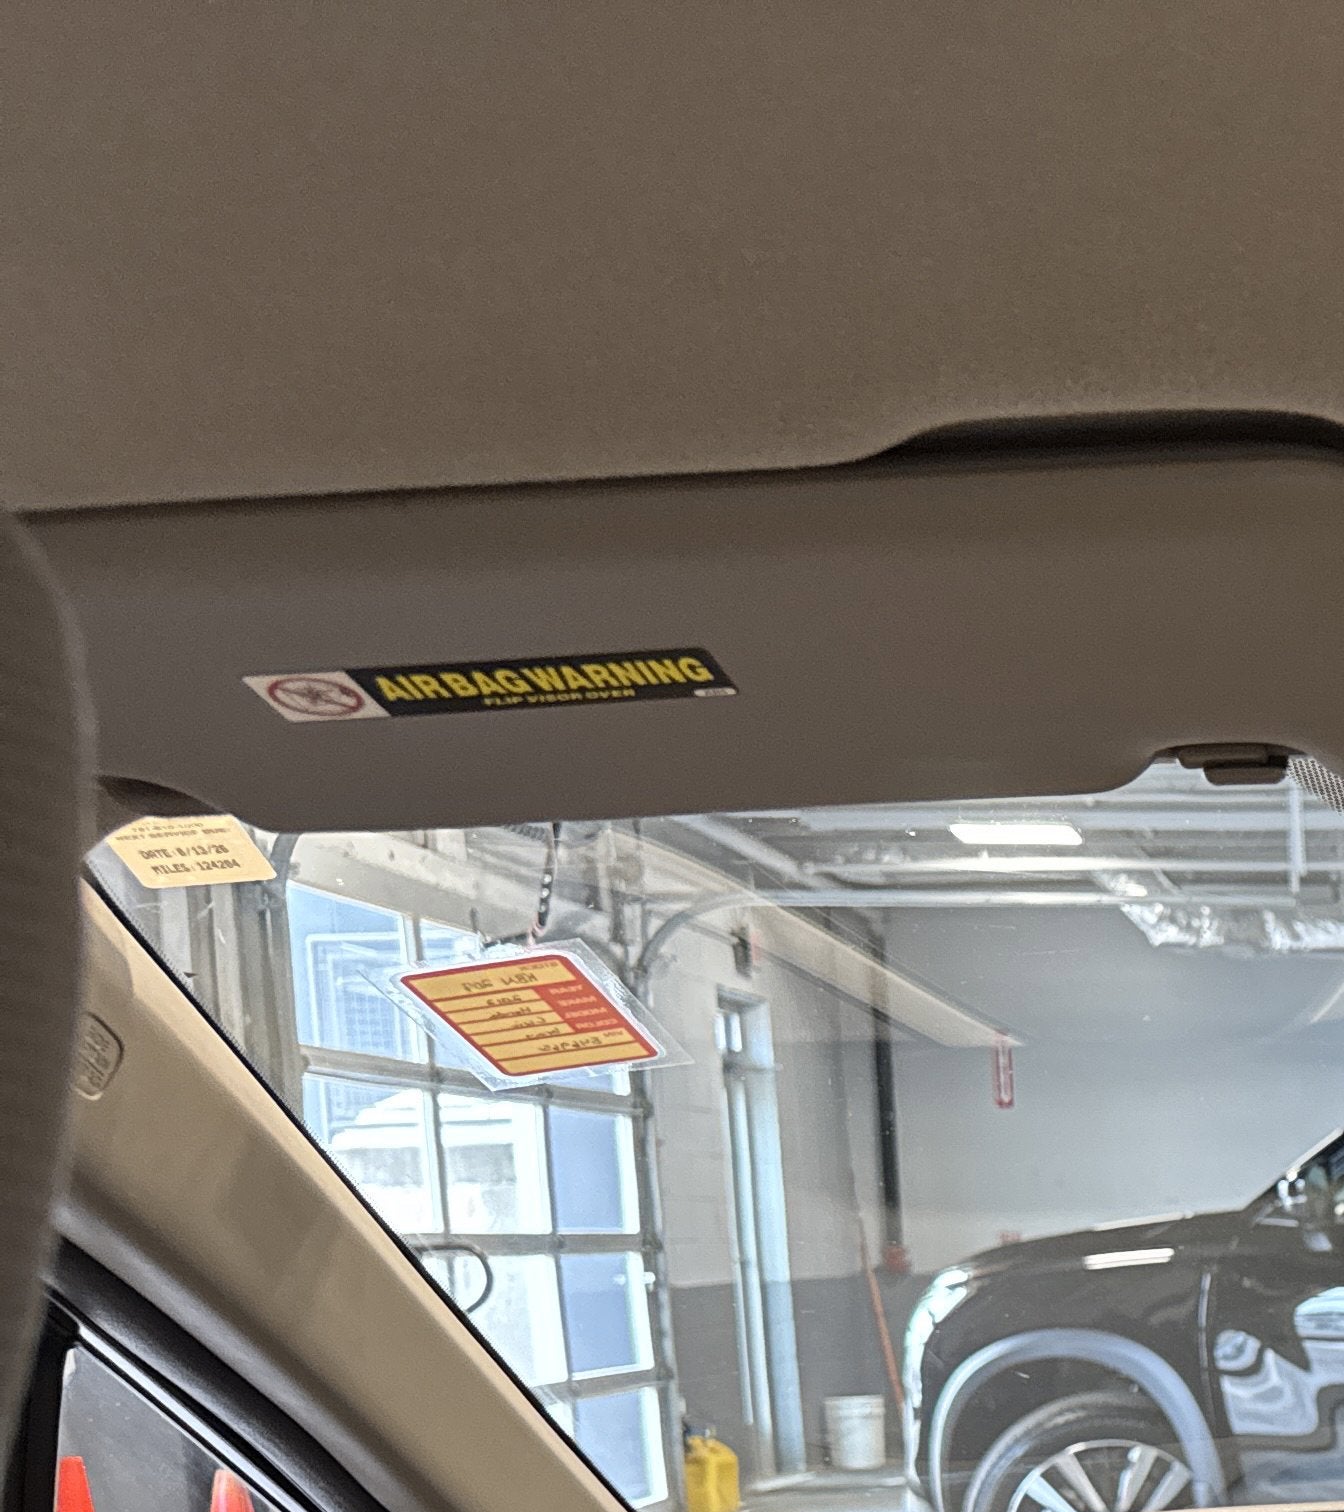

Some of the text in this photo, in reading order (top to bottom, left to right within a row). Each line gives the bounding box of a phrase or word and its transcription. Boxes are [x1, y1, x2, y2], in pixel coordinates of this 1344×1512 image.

[521, 657, 715, 693] WARNING
[484, 689, 636, 706] FLIP VISOR OVER
